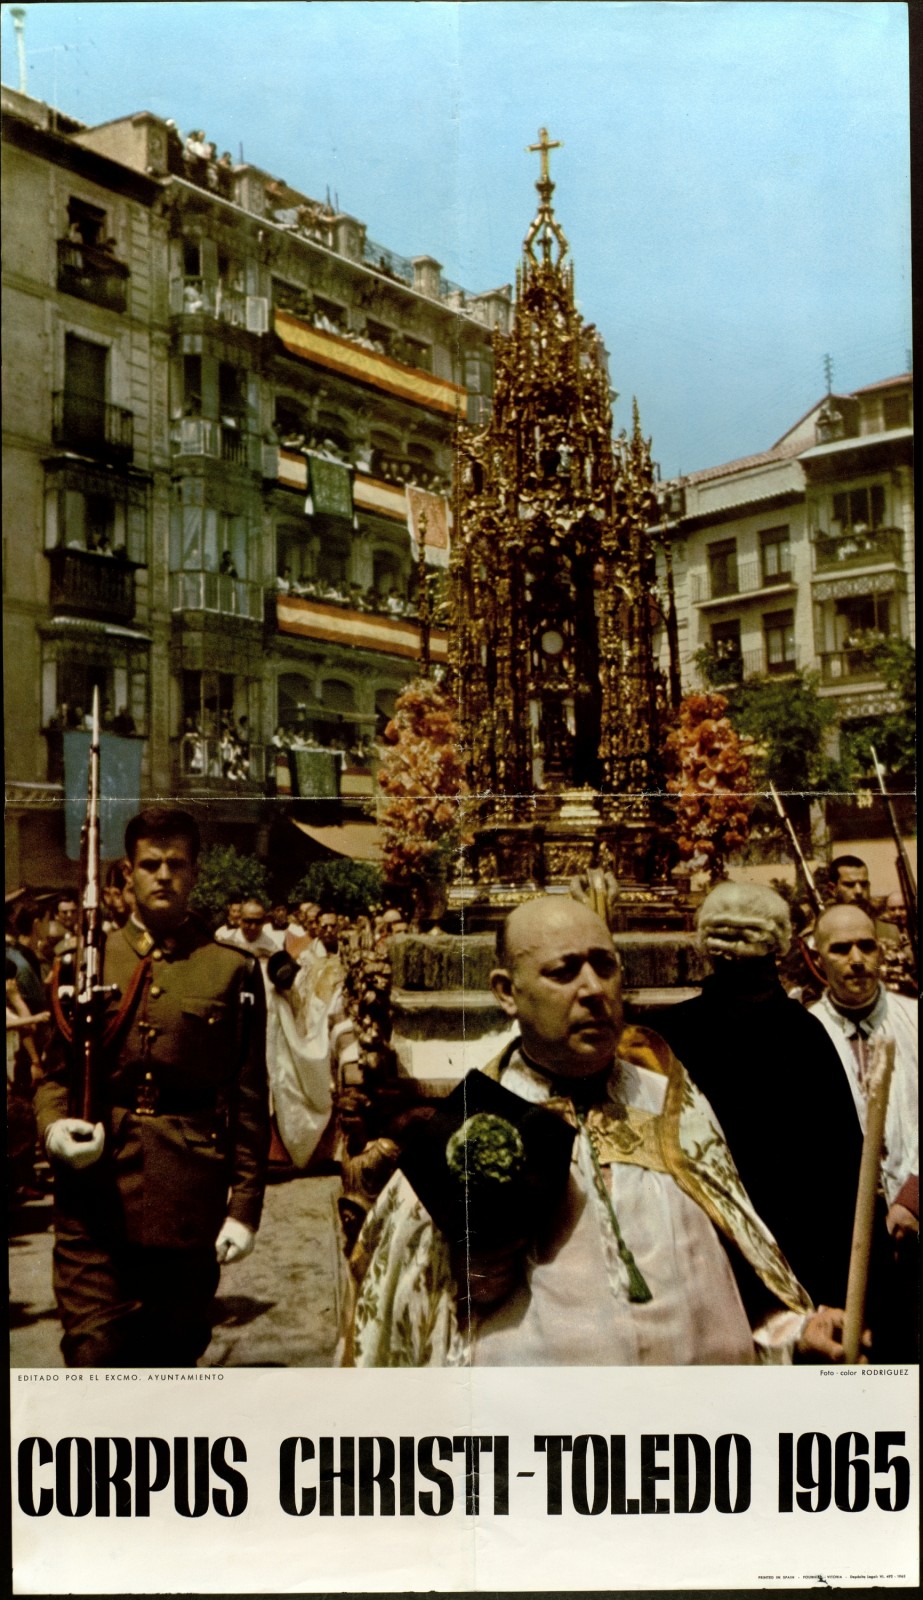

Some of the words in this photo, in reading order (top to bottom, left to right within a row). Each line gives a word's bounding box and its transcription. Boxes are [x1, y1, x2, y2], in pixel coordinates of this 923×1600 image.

[17, 1374, 60, 1382] EDITADO
[65, 1374, 84, 1382] POR
[105, 1373, 142, 1381] EXCMO.
[147, 1373, 225, 1381] AYUNTAMIENTO
[18, 1436, 249, 1518] CORPUS
[778, 1430, 911, 1513] 1965
